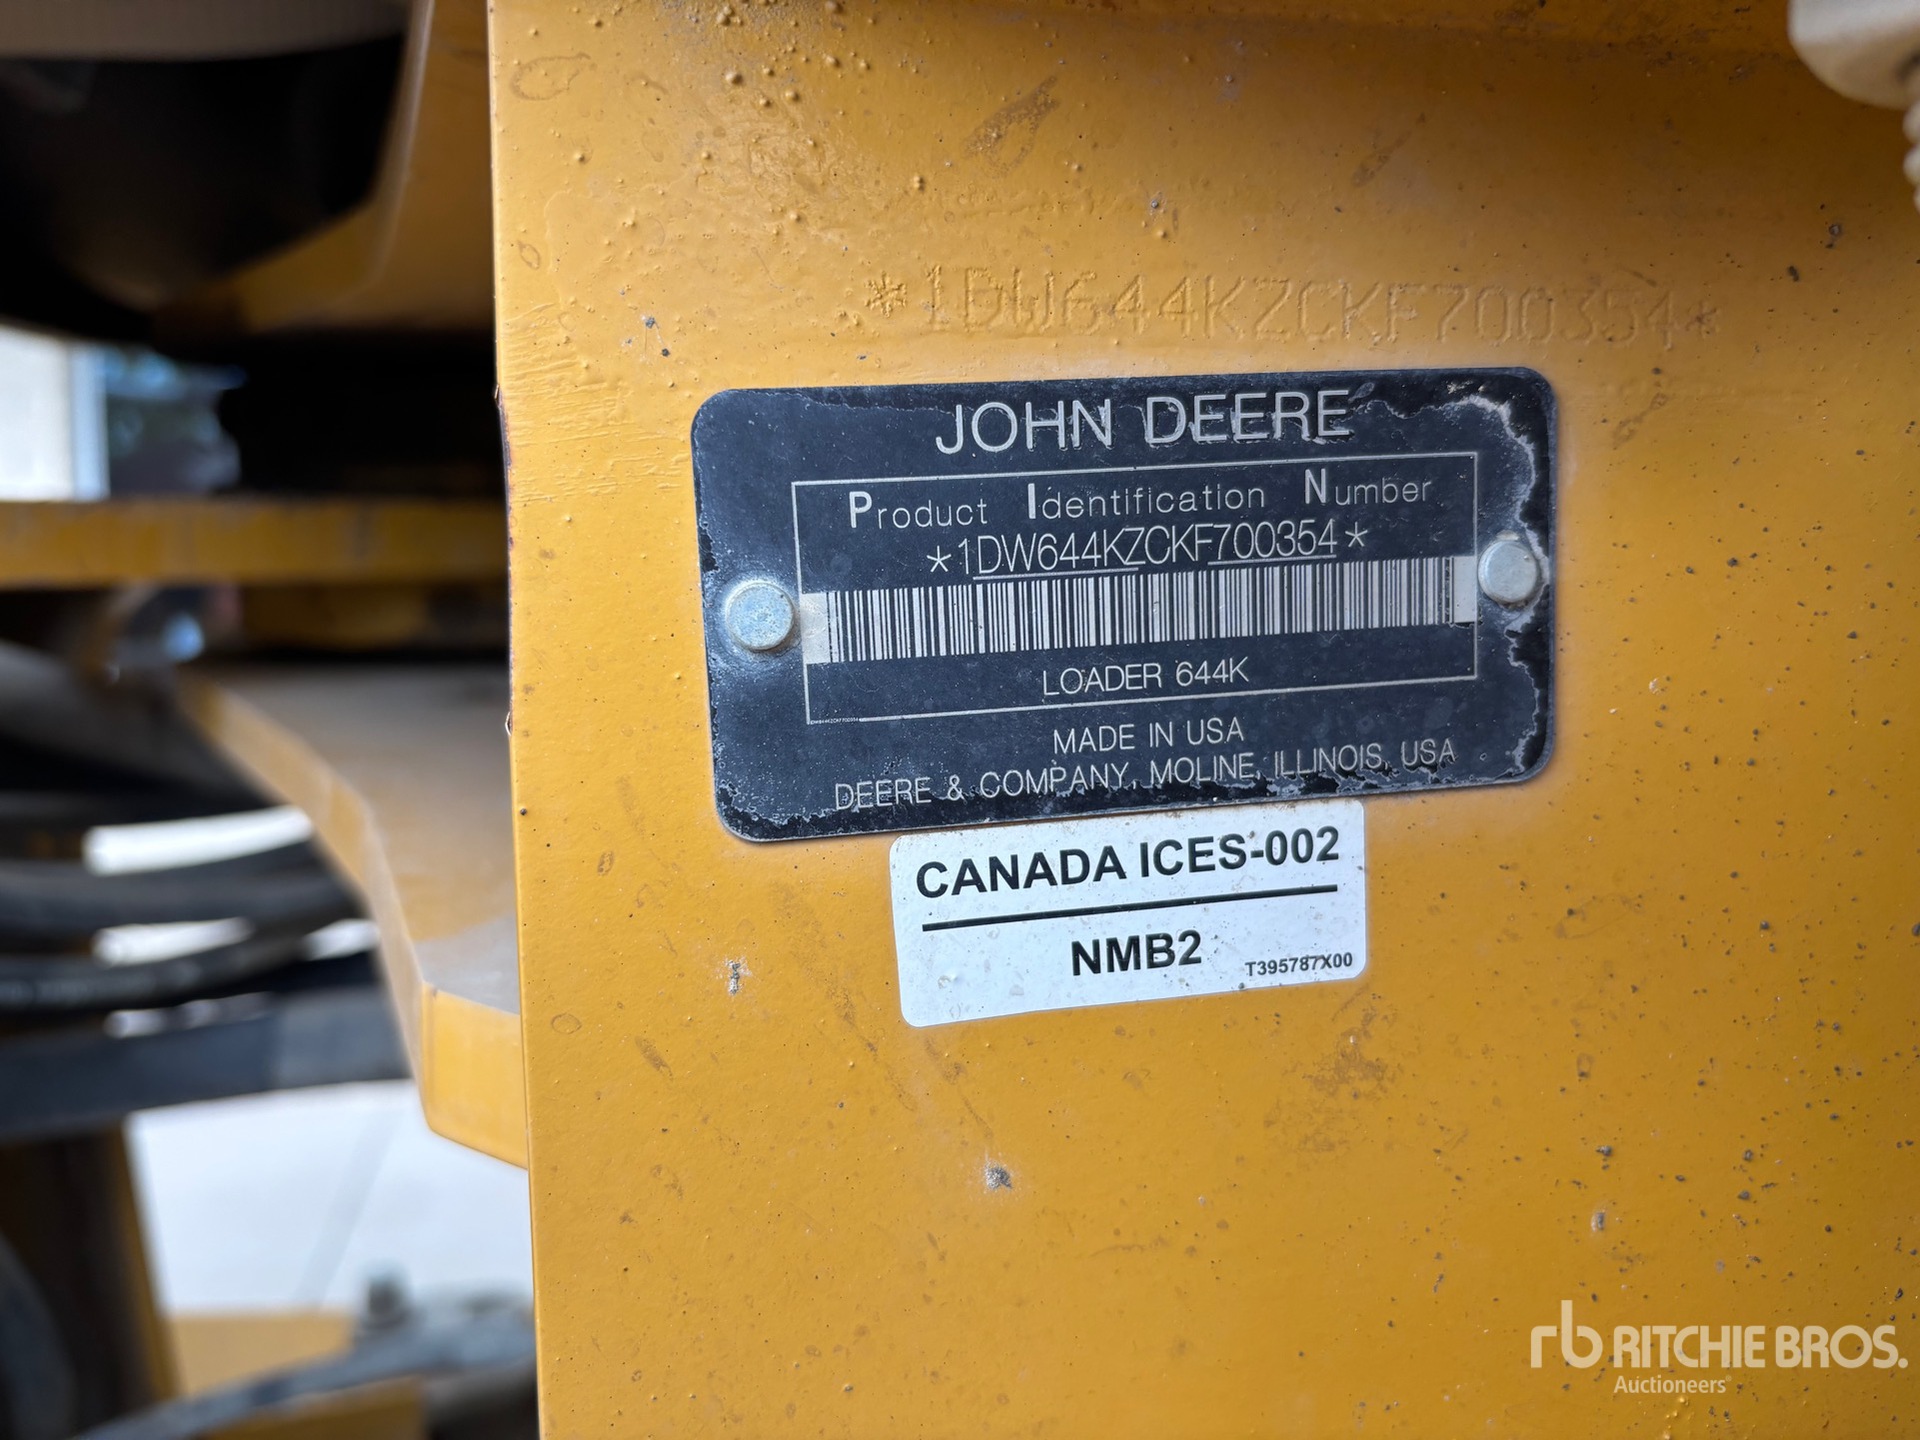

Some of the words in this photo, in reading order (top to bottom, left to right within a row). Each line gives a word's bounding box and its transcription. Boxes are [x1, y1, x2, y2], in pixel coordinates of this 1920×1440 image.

[935, 398, 1118, 455] JOHN
[1145, 389, 1353, 447] DEERE
[849, 490, 988, 529] Product
[1028, 482, 1265, 520] Identification
[1304, 468, 1432, 506] Number
[1042, 663, 1162, 697] LOADER
[1176, 656, 1250, 686] 644K
[1053, 723, 1136, 754] MADE
[1149, 721, 1173, 748] IN
[1186, 716, 1245, 745] USA
[834, 777, 932, 810] DEERE
[946, 774, 966, 801] &
[980, 761, 1138, 799] COMPANY,
[1400, 738, 1457, 767] USA
[916, 844, 1127, 899] CANADA
[1139, 824, 1340, 879] ICES-002
[1071, 929, 1202, 976] NMB2
[1245, 952, 1354, 978] T395787X00
